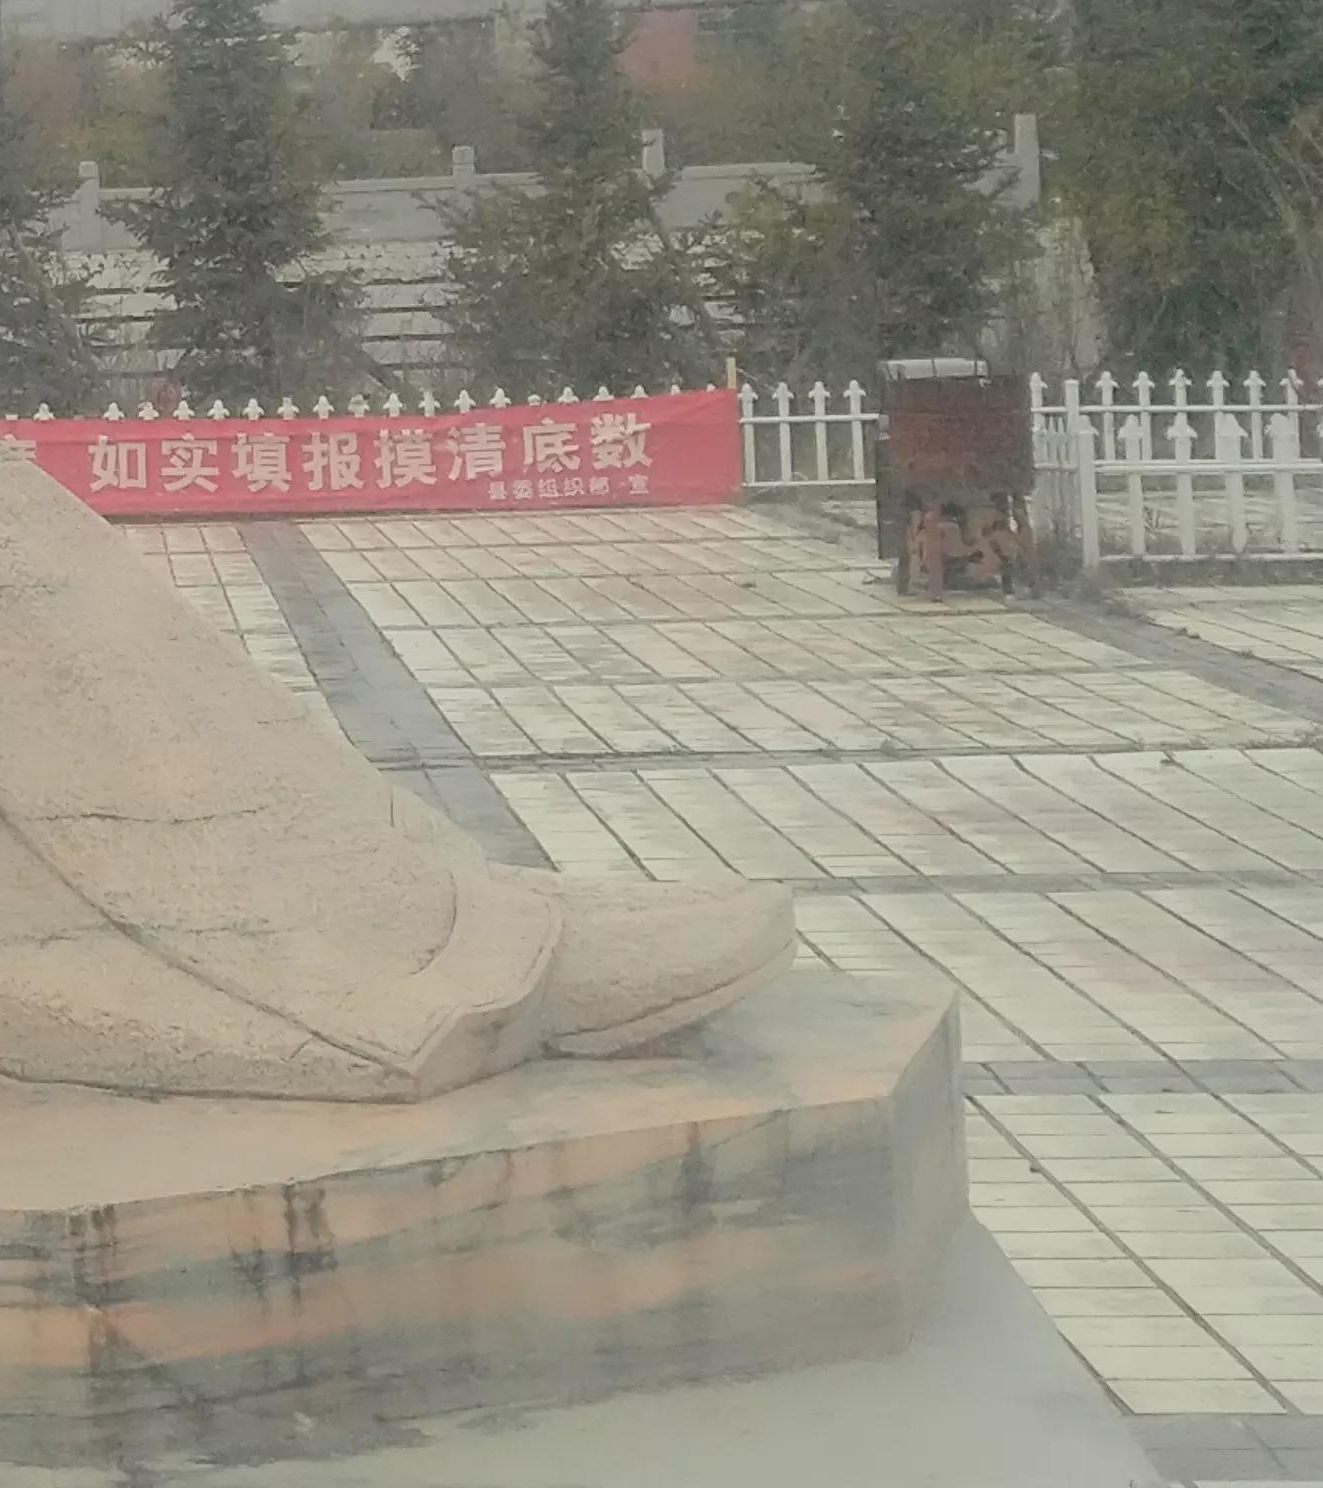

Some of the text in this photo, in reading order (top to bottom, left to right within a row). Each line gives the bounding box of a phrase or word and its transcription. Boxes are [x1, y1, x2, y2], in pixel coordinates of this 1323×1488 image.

[87, 412, 654, 493] 如实填报摸清底数
